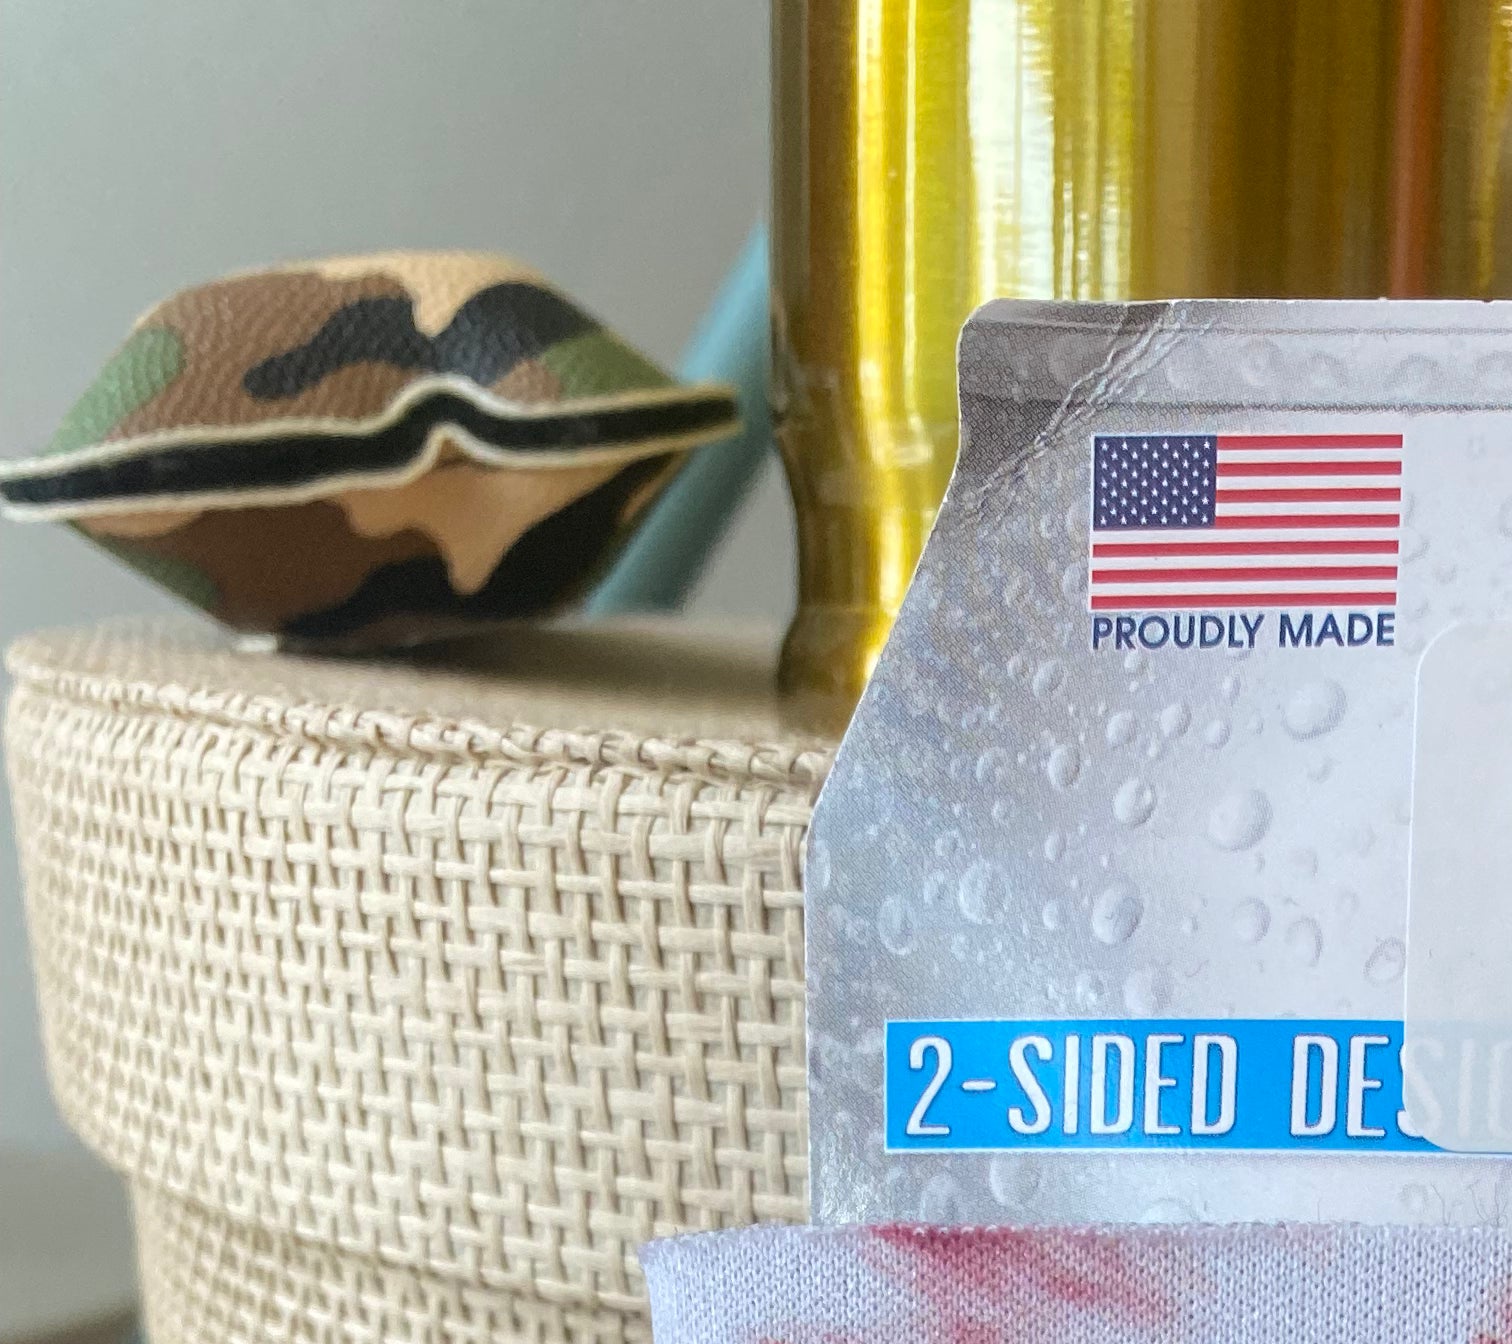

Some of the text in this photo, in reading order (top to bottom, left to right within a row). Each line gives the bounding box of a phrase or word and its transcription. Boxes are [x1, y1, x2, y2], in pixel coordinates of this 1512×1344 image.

[1092, 612, 1396, 650] PROUDLY MADE
[906, 1034, 1238, 1137] 2-SIDED
